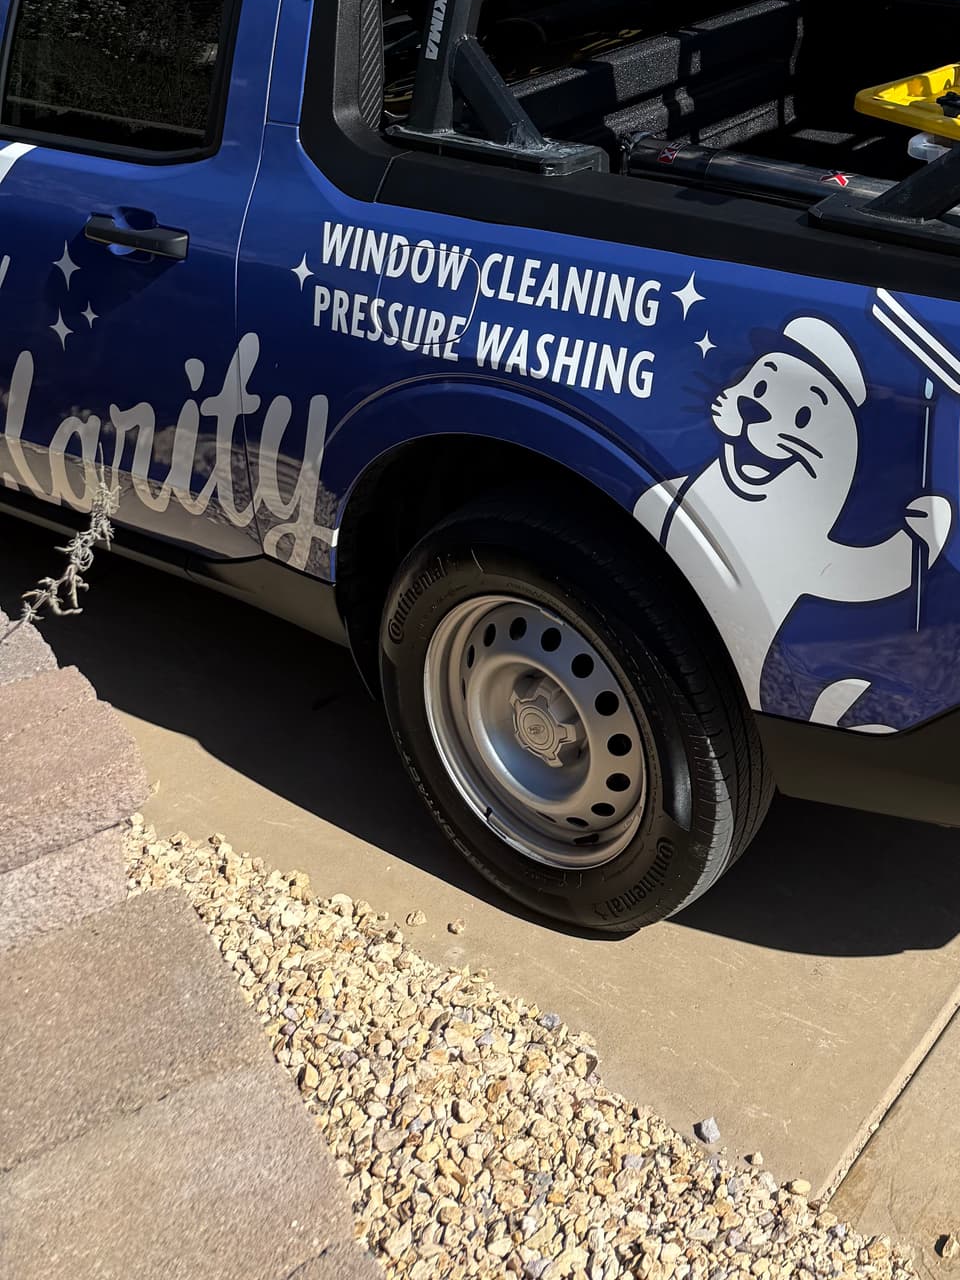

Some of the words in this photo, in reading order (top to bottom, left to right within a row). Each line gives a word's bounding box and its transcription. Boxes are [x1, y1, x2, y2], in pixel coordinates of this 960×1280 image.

[322, 221, 472, 291] WINDOW
[480, 252, 662, 327] CLEANING
[313, 285, 467, 362] PRESSURE
[476, 320, 655, 399] WASHING
[0, 331, 339, 571] larity
[605, 836, 675, 918] Continental
